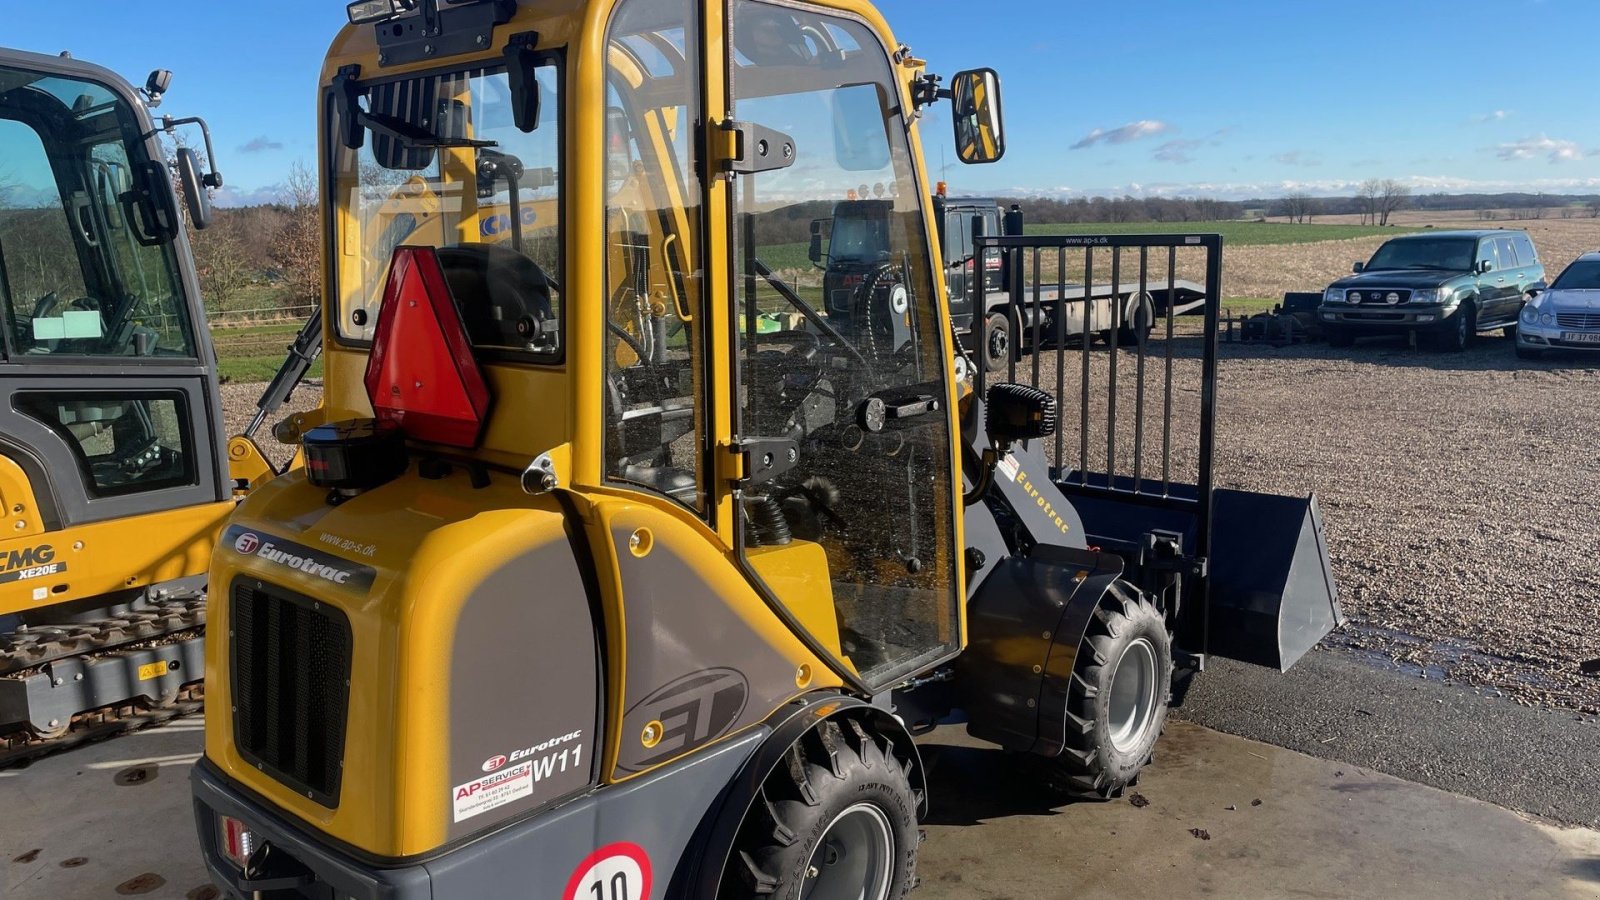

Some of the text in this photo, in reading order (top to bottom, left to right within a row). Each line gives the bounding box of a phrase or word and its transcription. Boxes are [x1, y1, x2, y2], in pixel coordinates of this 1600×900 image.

[1066, 236, 1108, 245] www.ap-s.dk
[1016, 471, 1069, 533] Eurotrac
[319, 531, 377, 557] www.ap-s.dk
[19, 564, 58, 580] XE20E
[257, 542, 350, 584] Eurotrac
[509, 729, 582, 762] Eurotrac
[533, 744, 582, 782] W11
[456, 766, 525, 800] AP SERVICE
[590, 871, 628, 900] 10
